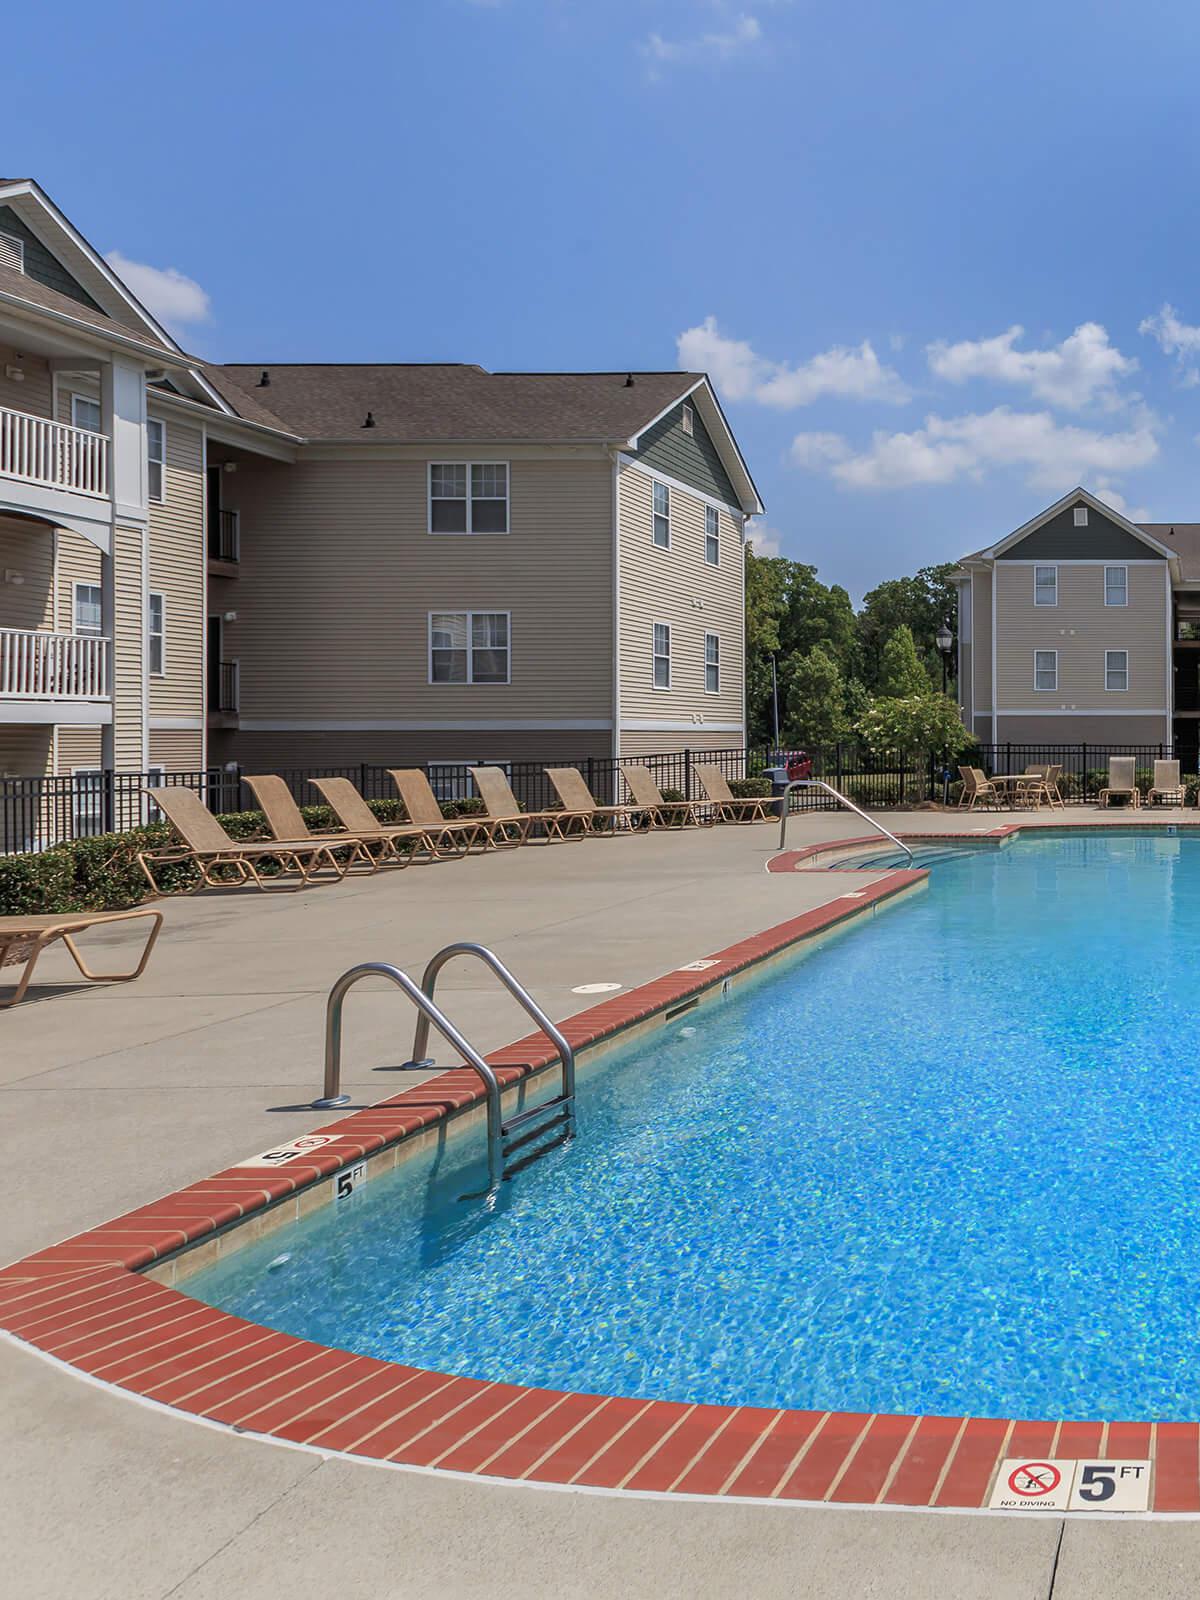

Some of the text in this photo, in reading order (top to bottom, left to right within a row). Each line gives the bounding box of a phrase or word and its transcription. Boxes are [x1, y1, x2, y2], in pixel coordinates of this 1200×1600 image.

[262, 1151, 300, 1159] 5
[337, 1165, 365, 1200] 5 FT
[1079, 1466, 1145, 1502] 5 FT
